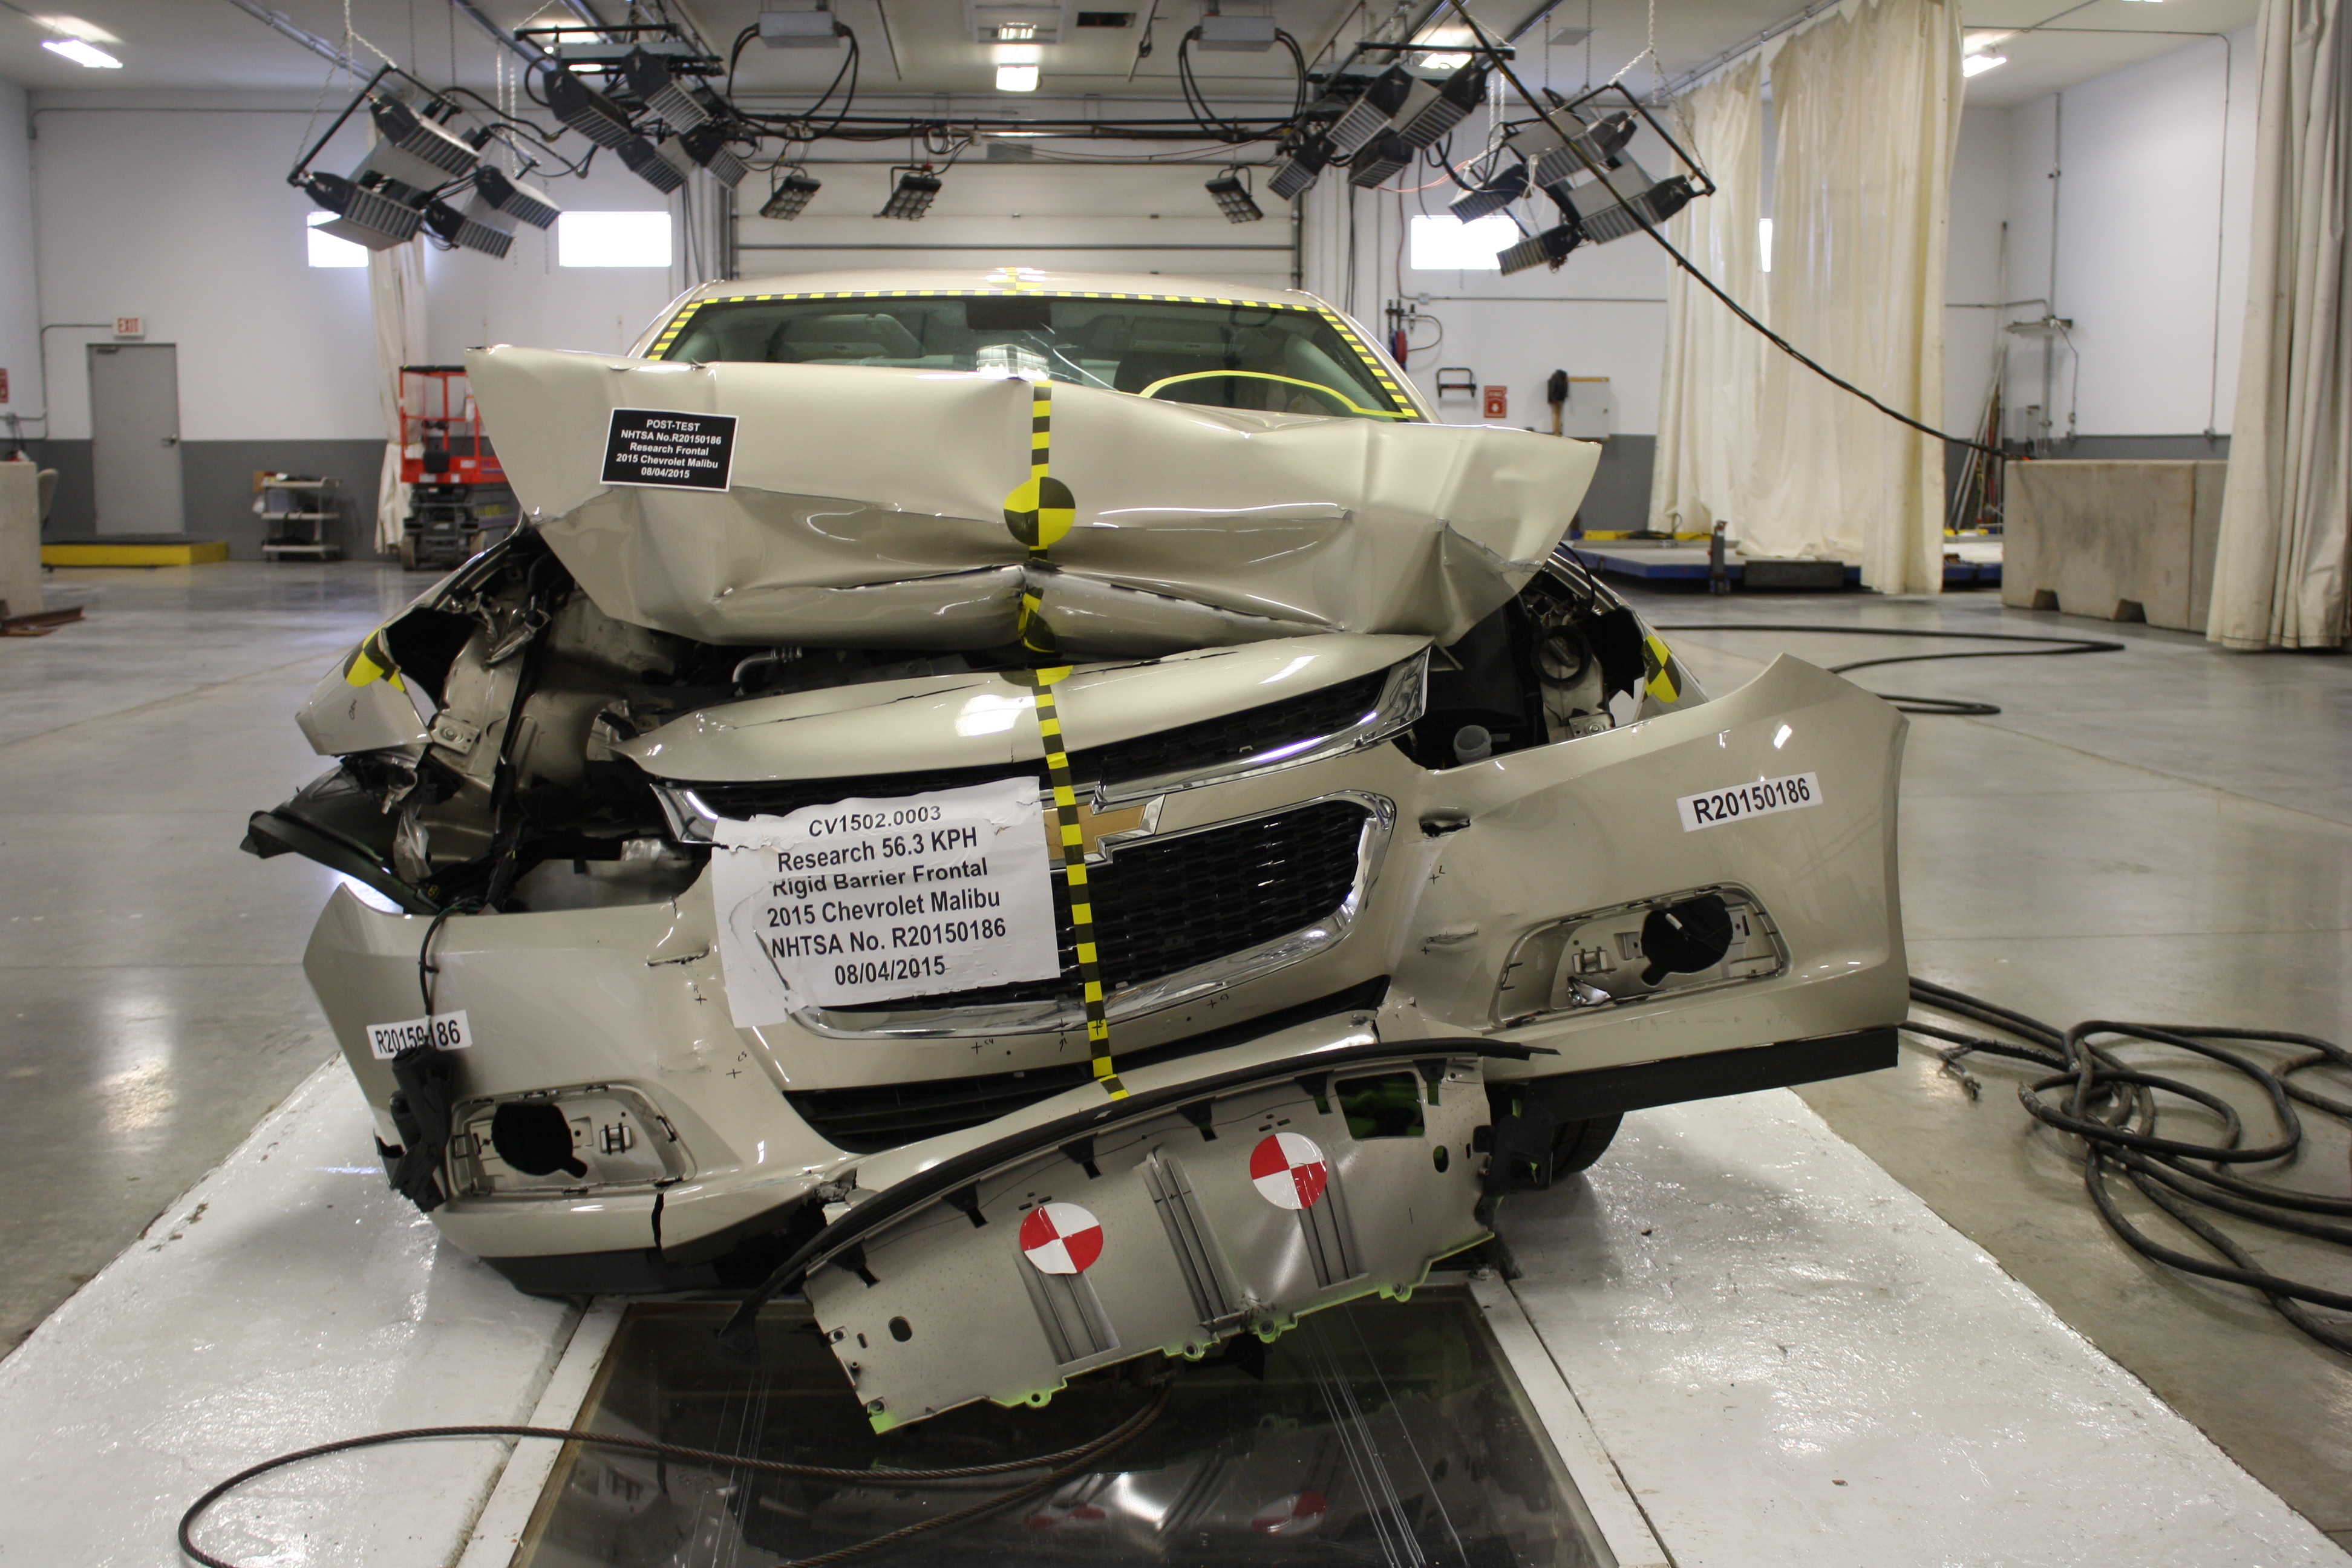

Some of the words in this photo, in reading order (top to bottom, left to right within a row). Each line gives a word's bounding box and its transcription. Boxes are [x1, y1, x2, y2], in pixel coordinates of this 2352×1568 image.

[117, 318, 138, 333] EXIT
[621, 430, 654, 440] NHTSA
[647, 419, 701, 431] POST-TEST
[616, 453, 638, 463] 2015
[640, 454, 685, 466] Chevrolet
[687, 459, 718, 468] Malibu
[630, 442, 673, 454] Research
[676, 447, 709, 456] Frontal
[641, 466, 690, 479] 08/04/2015
[1693, 777, 1810, 824] R20150186
[809, 805, 941, 837] CV1502.0003
[778, 843, 875, 873] Research
[882, 834, 925, 857] 56.3
[932, 826, 977, 852] KPH
[772, 874, 827, 899] Rigid
[834, 870, 906, 890] Barrier
[913, 857, 987, 882] Frontal
[767, 903, 815, 928] 2015
[822, 894, 925, 923] Chevrolet
[931, 889, 1000, 913] Malibu
[772, 933, 844, 958] NHTSA
[850, 930, 885, 952] No.
[892, 918, 1006, 949] R20150186
[835, 955, 946, 986] 08/04/2015
